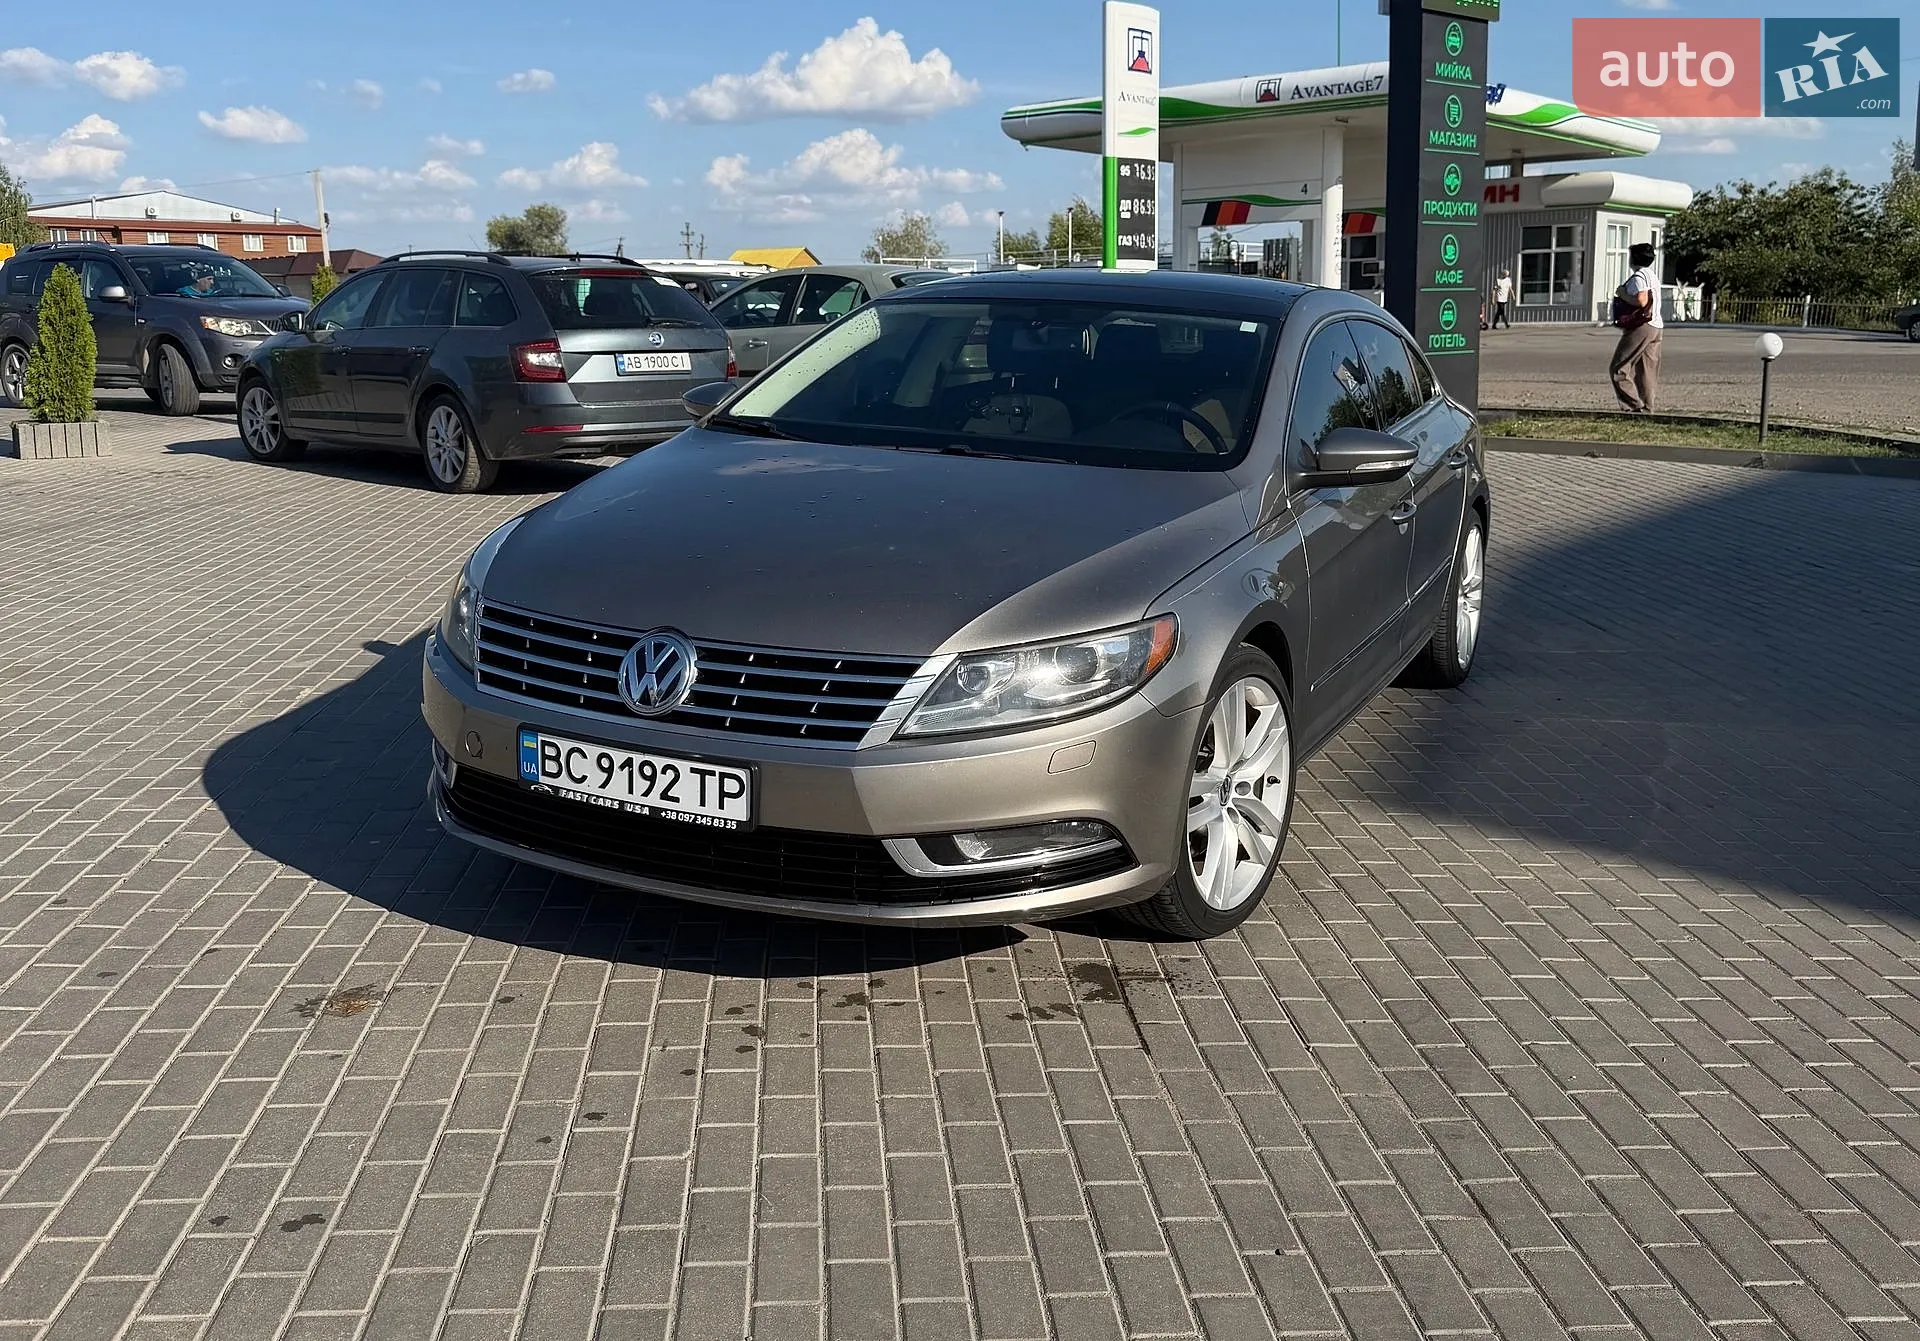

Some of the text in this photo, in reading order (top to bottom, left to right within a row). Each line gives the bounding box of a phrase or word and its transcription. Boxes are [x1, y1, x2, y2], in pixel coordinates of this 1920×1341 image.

[1435, 61, 1473, 81] МИЙКА
[1428, 130, 1477, 148] МАГАЗИН
[1300, 183, 1308, 195] 4
[1423, 200, 1478, 218] ПРОДУКТИ
[1117, 234, 1133, 247] ГАЗ
[1434, 268, 1464, 284] КАФЕ
[1429, 333, 1467, 349] ГОТЕЛЬ
[626, 356, 642, 369] AB
[644, 355, 669, 369] 1900
[523, 760, 538, 775] UA
[541, 739, 746, 811] BC 9192 TP
[558, 788, 650, 816] FAST CARS USA
[660, 810, 737, 830] +38 097 345 83 35
